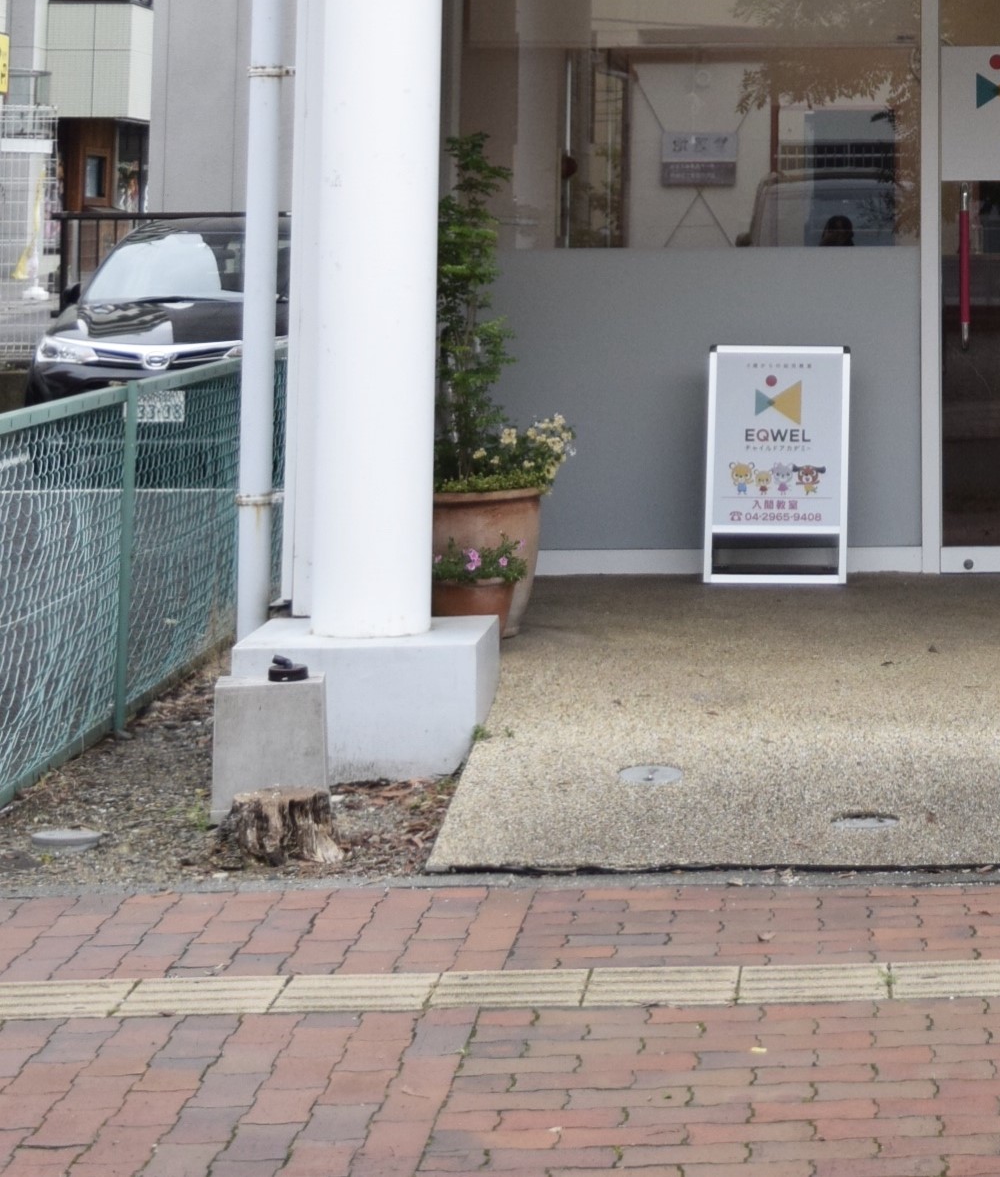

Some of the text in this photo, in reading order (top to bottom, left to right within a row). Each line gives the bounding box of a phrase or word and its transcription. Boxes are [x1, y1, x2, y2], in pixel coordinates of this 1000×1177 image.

[745, 428, 811, 443] EQWEL
[752, 499, 798, 510] 入間教室
[745, 512, 822, 522] 04-2965-9408
